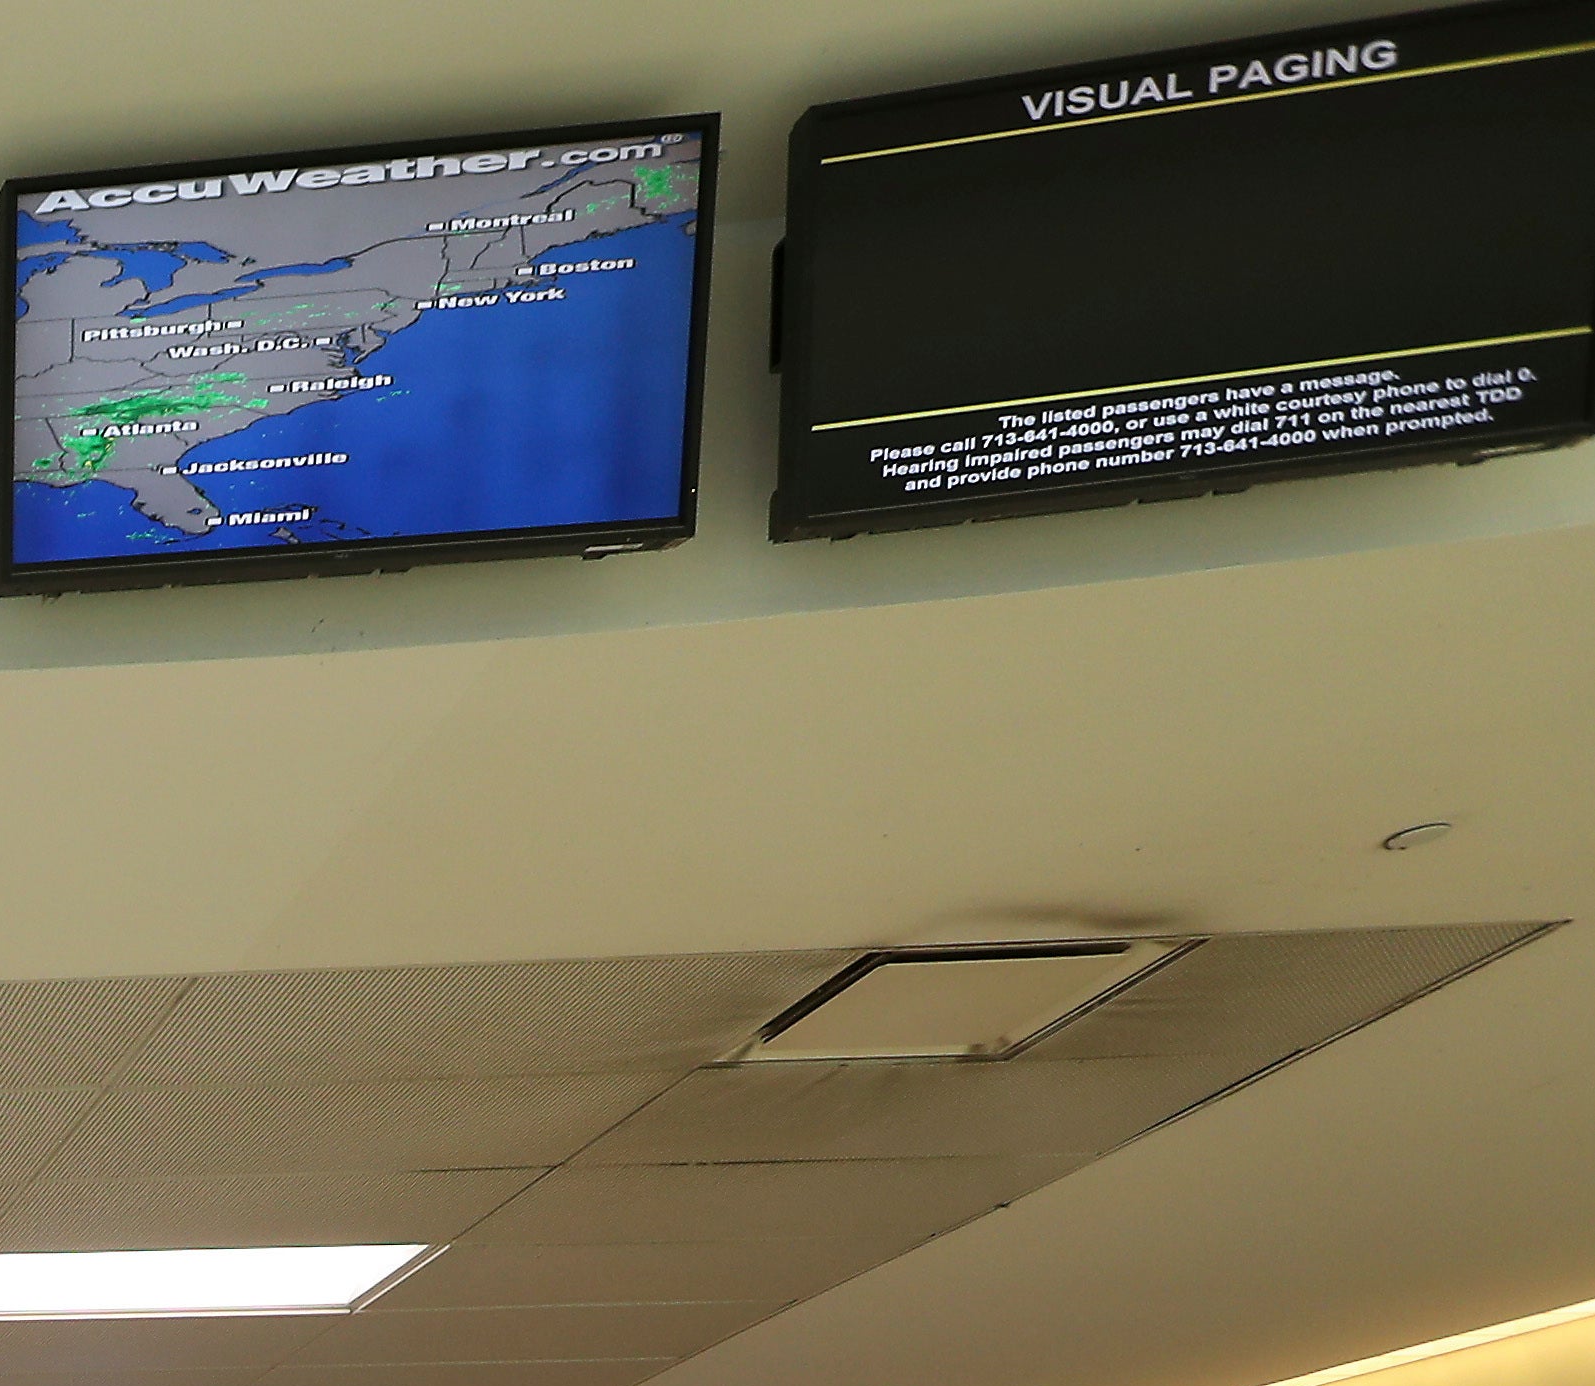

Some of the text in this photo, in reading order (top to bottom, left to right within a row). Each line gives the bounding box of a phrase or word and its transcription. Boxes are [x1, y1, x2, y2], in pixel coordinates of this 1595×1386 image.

[1022, 40, 1398, 121] VISUAL PAGING
[451, 209, 576, 231] Montreal
[540, 258, 635, 276] Boston
[438, 287, 566, 310] New York
[82, 320, 221, 343] Pittsburgh
[168, 337, 309, 359] Wash. D.C.
[291, 374, 393, 393] Raleigh
[998, 369, 1401, 429] The listed passengers have a message.
[870, 366, 1538, 462] Please call 713-641-4000, or use a white courtesy phone to dial 0.
[103, 420, 199, 437] Atlanta
[882, 457, 959, 478] Hearing
[1058, 431, 1175, 459] passengers
[1180, 425, 1225, 442] may
[1230, 418, 1269, 435] dial
[1274, 412, 1311, 430] 711
[1317, 409, 1345, 424] on
[1350, 404, 1385, 421] the
[1389, 393, 1471, 416] nearest
[1474, 386, 1523, 405] TDD
[904, 408, 1495, 492] and provide phone number 713-641-4000 when prompted.
[182, 452, 349, 476] Jacksonville
[228, 508, 310, 527] Miami
